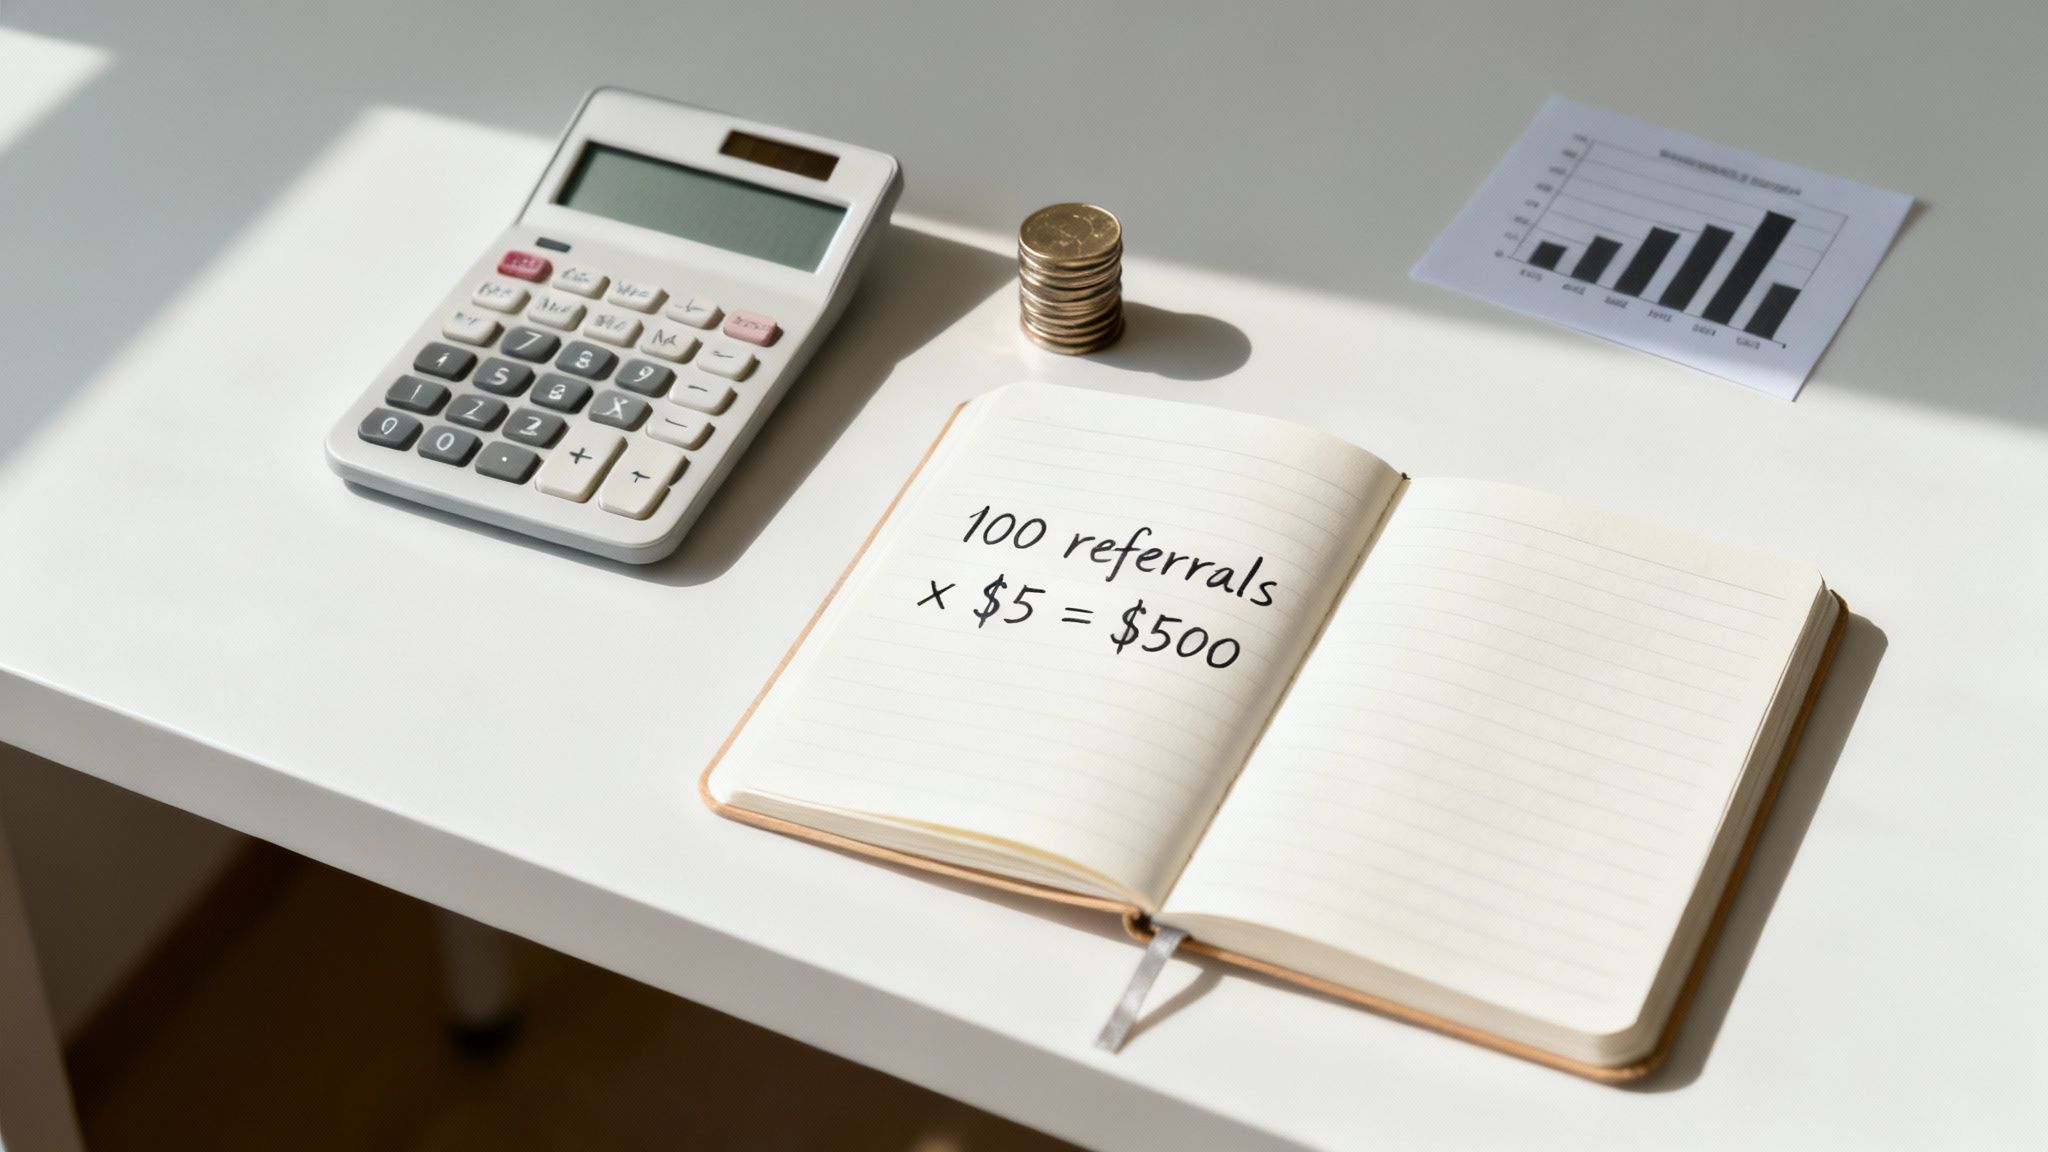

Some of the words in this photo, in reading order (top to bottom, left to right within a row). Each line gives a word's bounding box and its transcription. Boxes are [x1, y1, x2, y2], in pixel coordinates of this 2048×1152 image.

[516, 331, 542, 351] 7
[575, 350, 594, 369] 8
[436, 432, 456, 451] 0
[963, 505, 1047, 549] 100
[1063, 527, 1278, 606] referrals
[973, 573, 1047, 628] $5
[1061, 607, 1094, 624] =
[1110, 599, 1241, 669] $500
